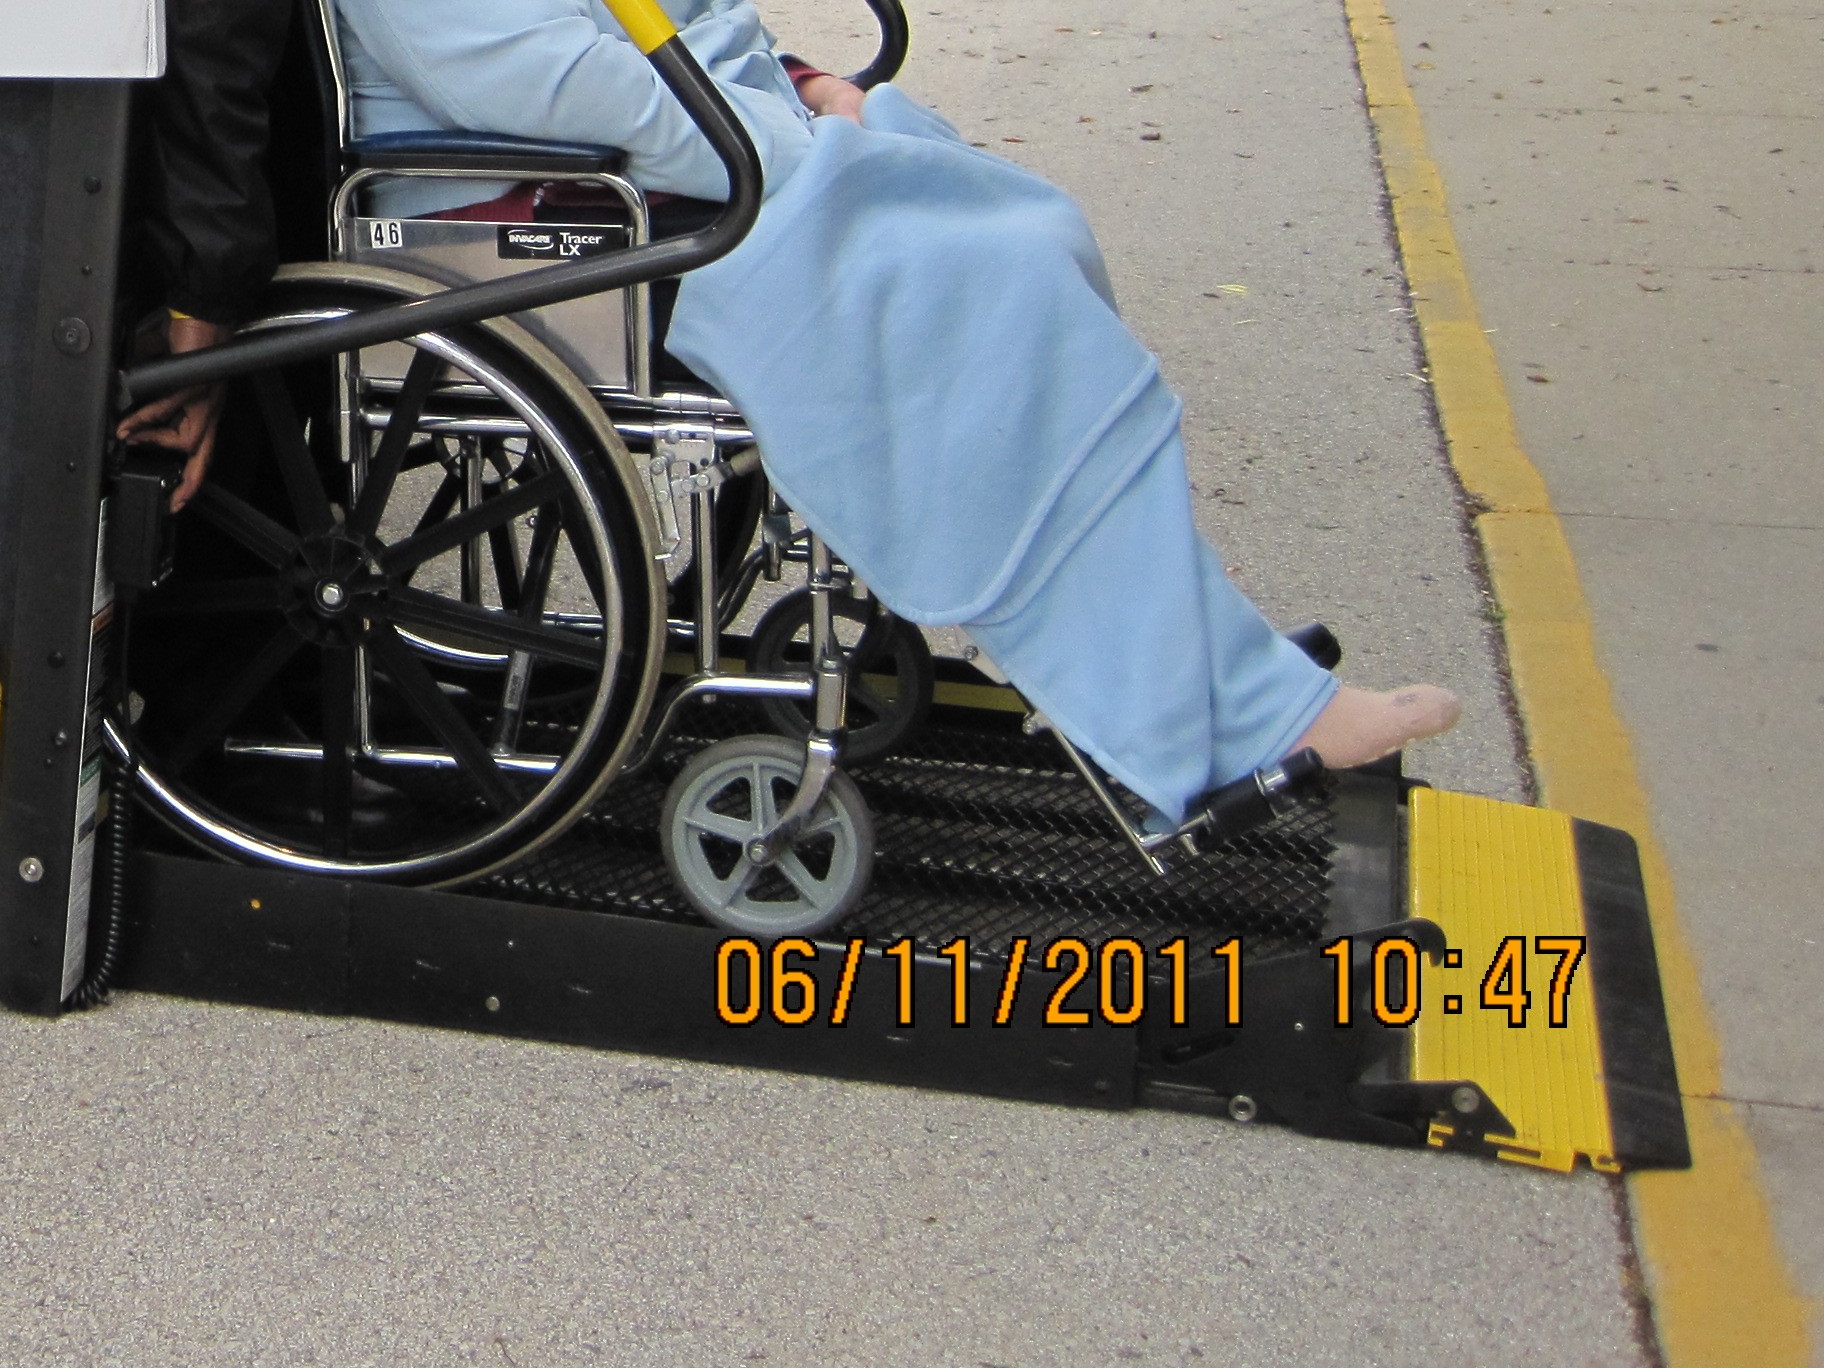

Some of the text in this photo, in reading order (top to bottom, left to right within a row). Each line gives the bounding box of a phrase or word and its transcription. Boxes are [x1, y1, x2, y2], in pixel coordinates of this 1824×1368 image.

[372, 222, 400, 246] 46
[559, 232, 603, 244] Tracer
[559, 244, 581, 256] LX
